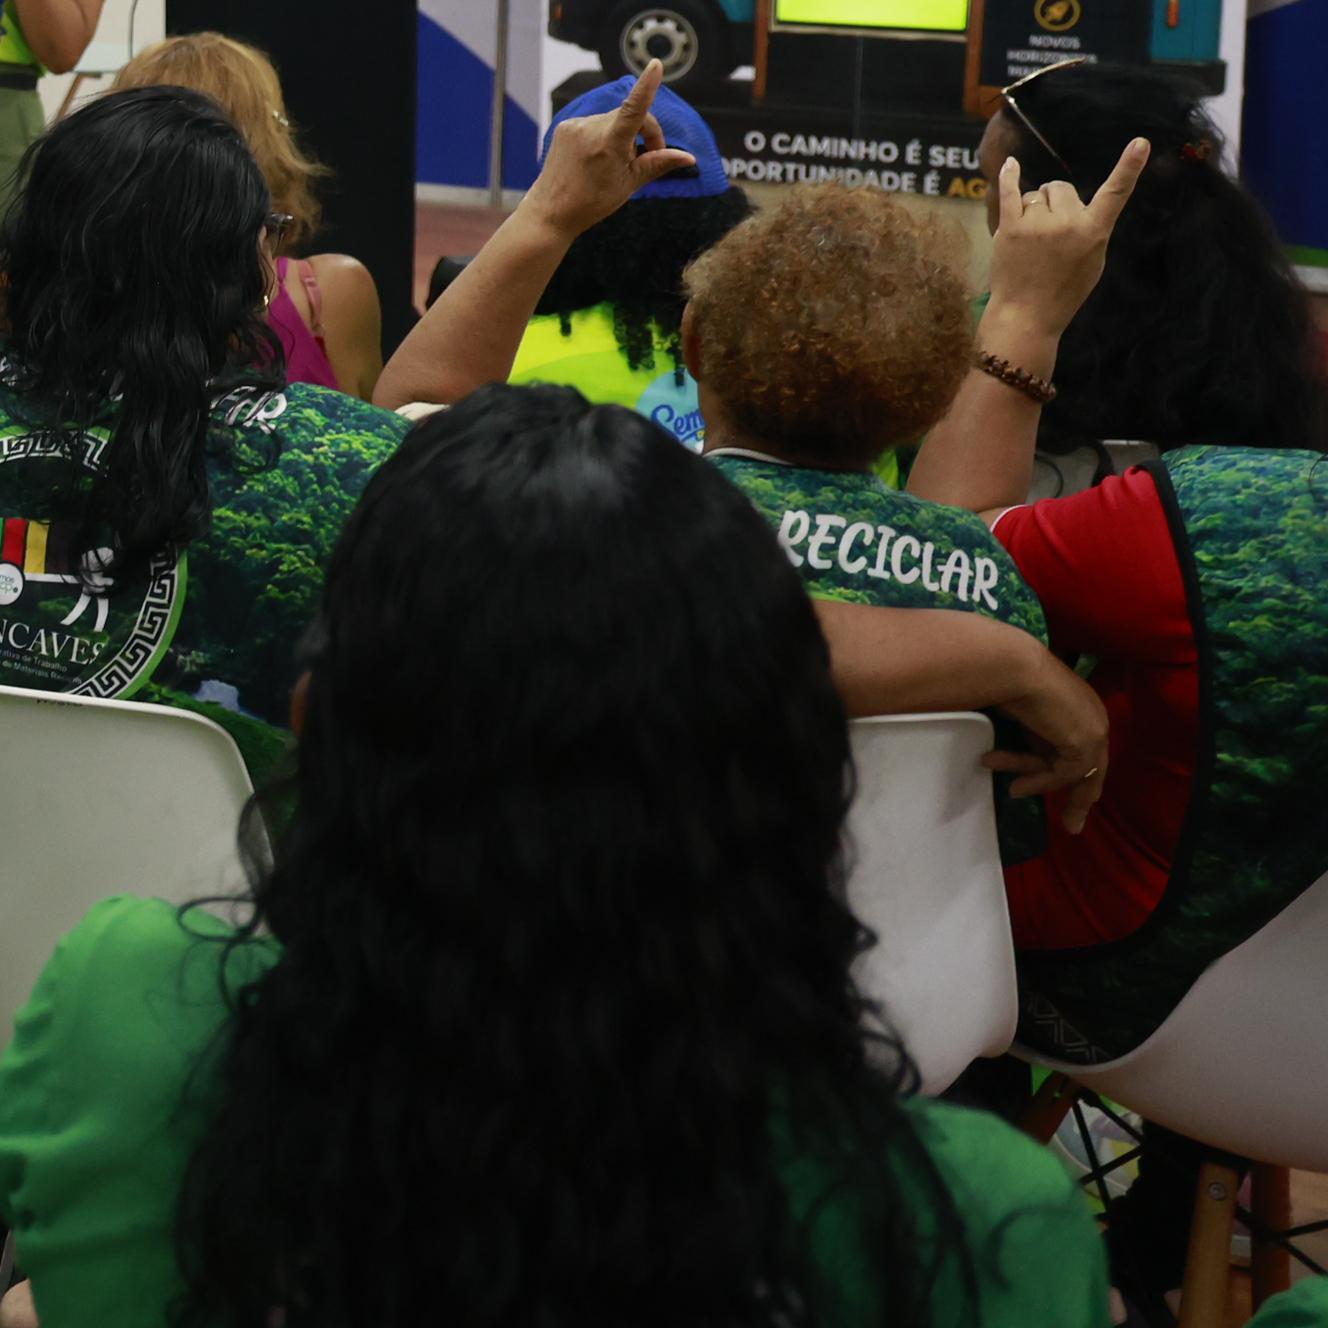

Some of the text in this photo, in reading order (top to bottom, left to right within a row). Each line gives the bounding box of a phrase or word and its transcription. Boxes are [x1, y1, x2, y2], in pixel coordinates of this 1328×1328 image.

[743, 130, 767, 153] O
[771, 131, 899, 163] CAMINHO
[905, 138, 922, 166] É
[923, 171, 941, 196] É
[778, 509, 999, 611] RECICLAR
